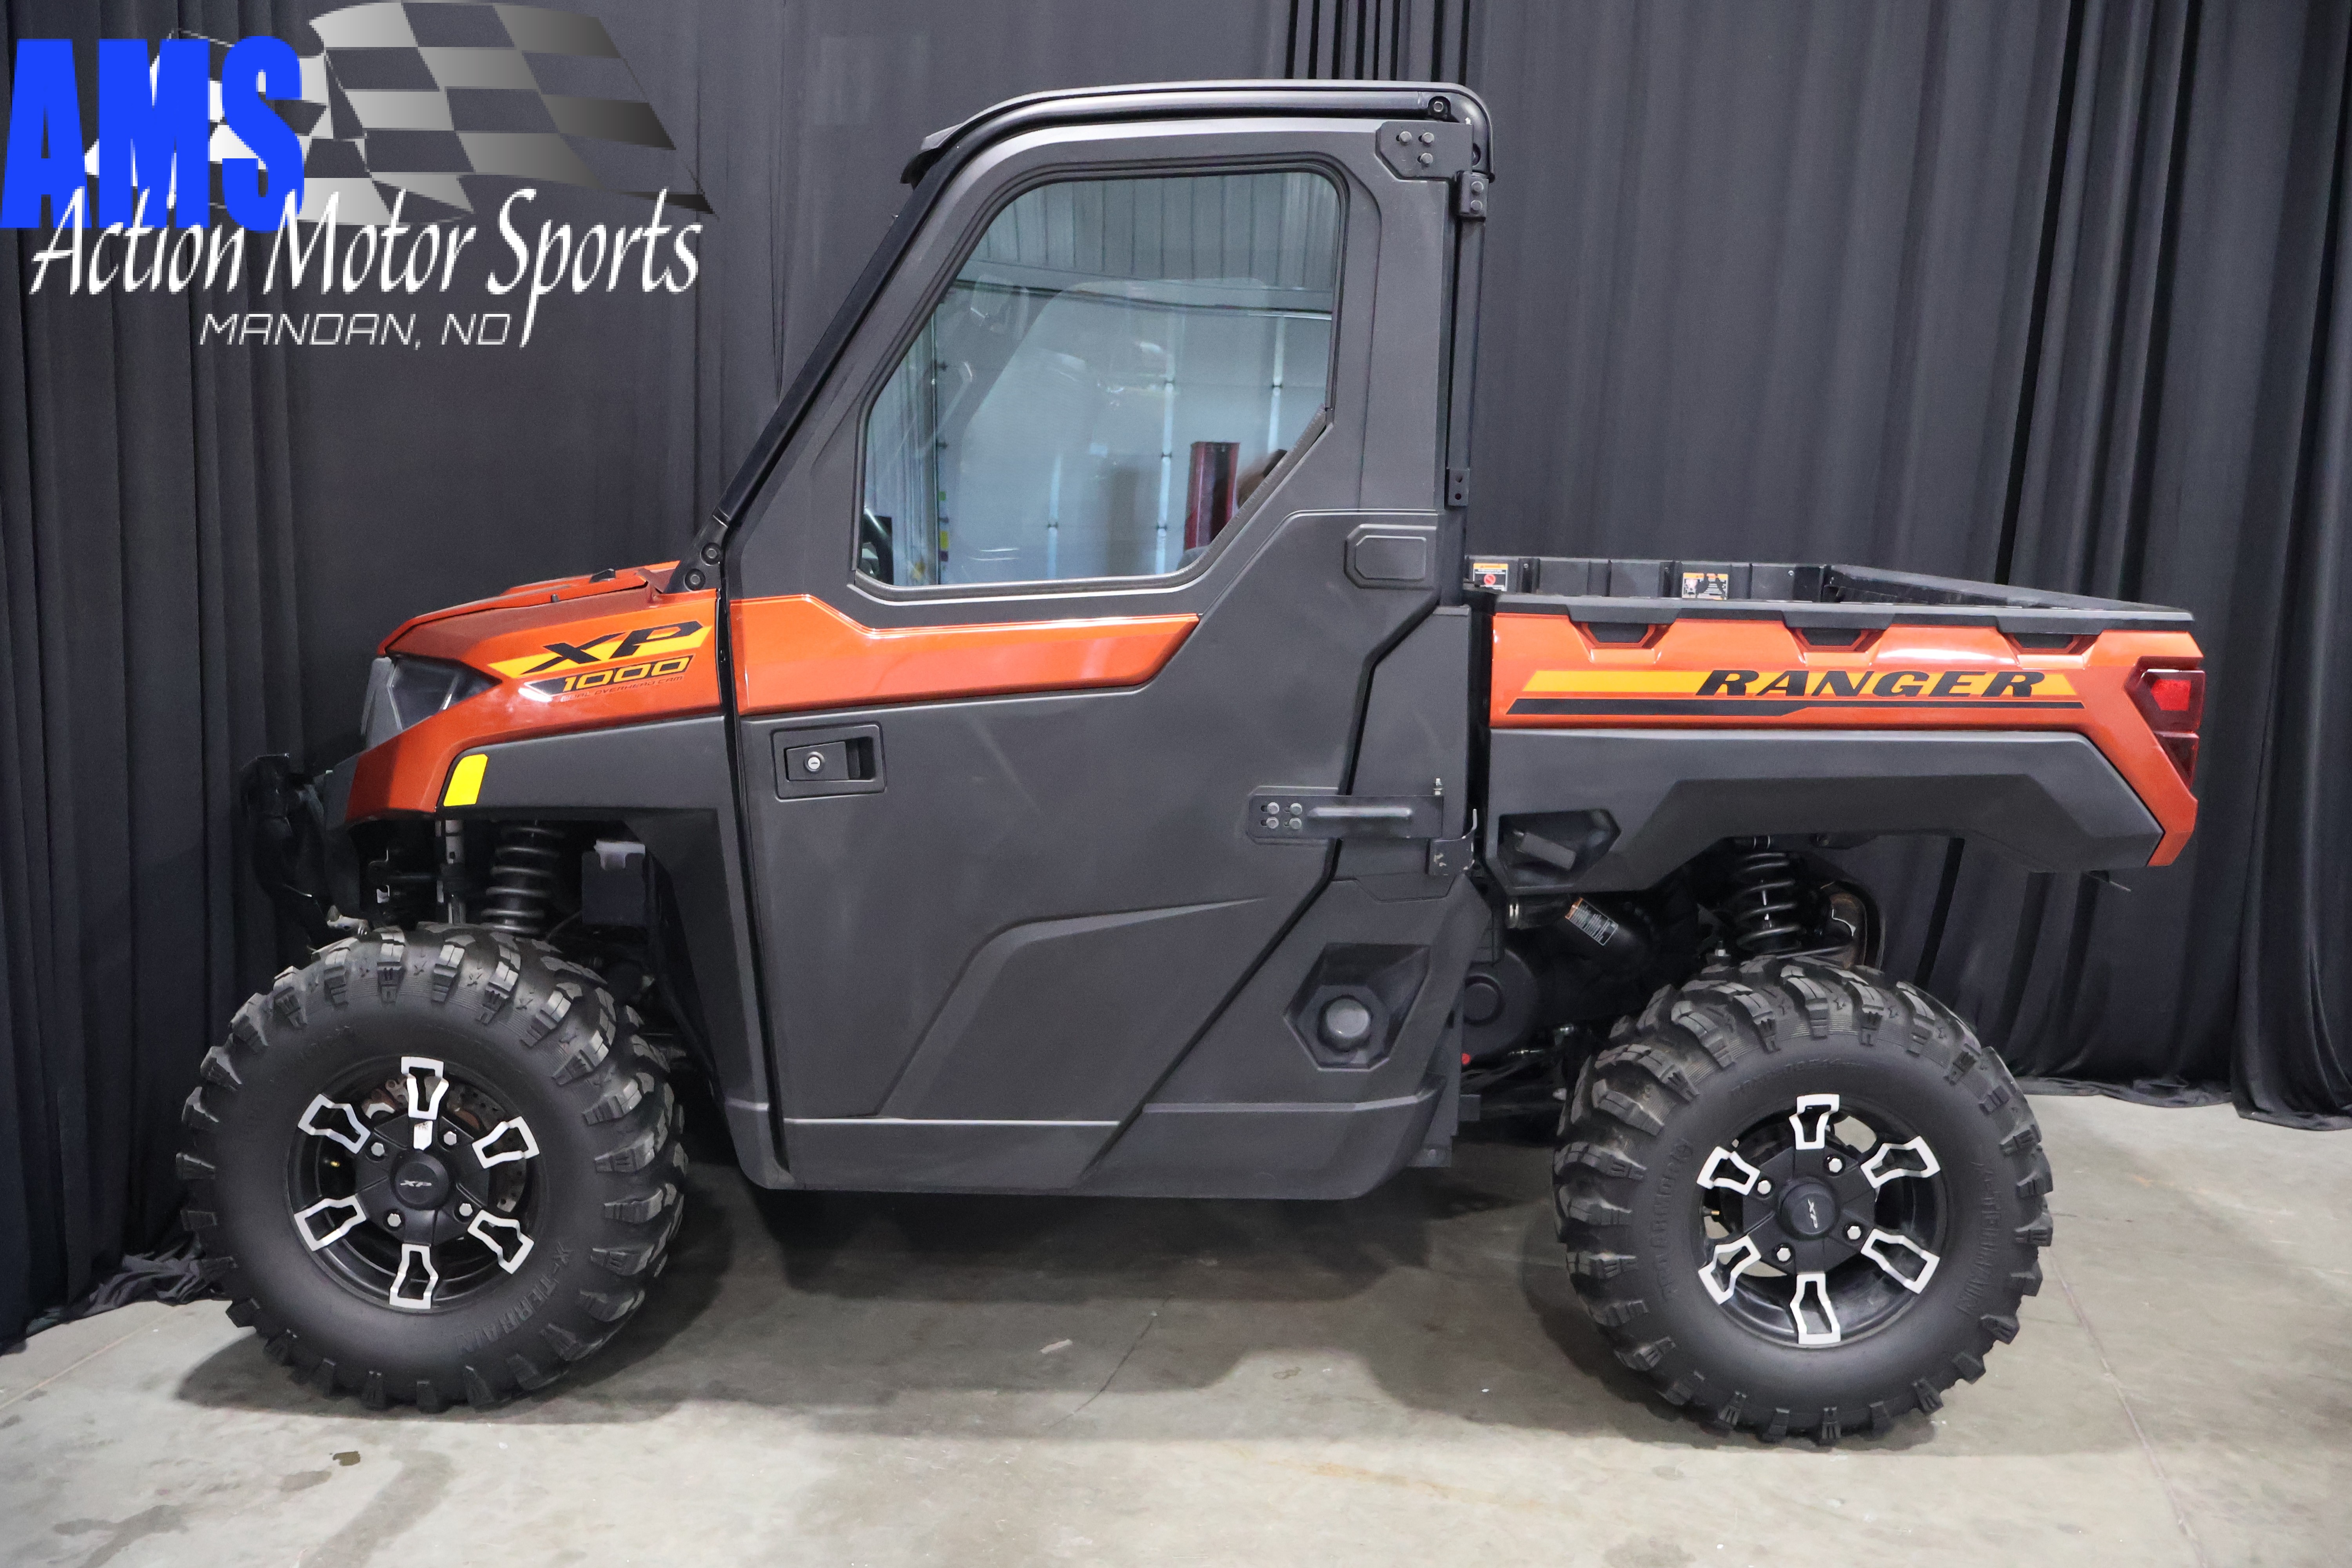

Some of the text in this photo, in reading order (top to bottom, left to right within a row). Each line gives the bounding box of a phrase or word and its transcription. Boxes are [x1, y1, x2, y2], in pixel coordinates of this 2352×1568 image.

[520, 621, 703, 674] XP
[563, 657, 689, 691] 1000
[594, 681, 655, 695] OVERHEAD
[1695, 670, 2045, 697] RANGER
[1807, 1198, 1818, 1229] XP
[455, 1241, 573, 1354] X-TERRAIN
